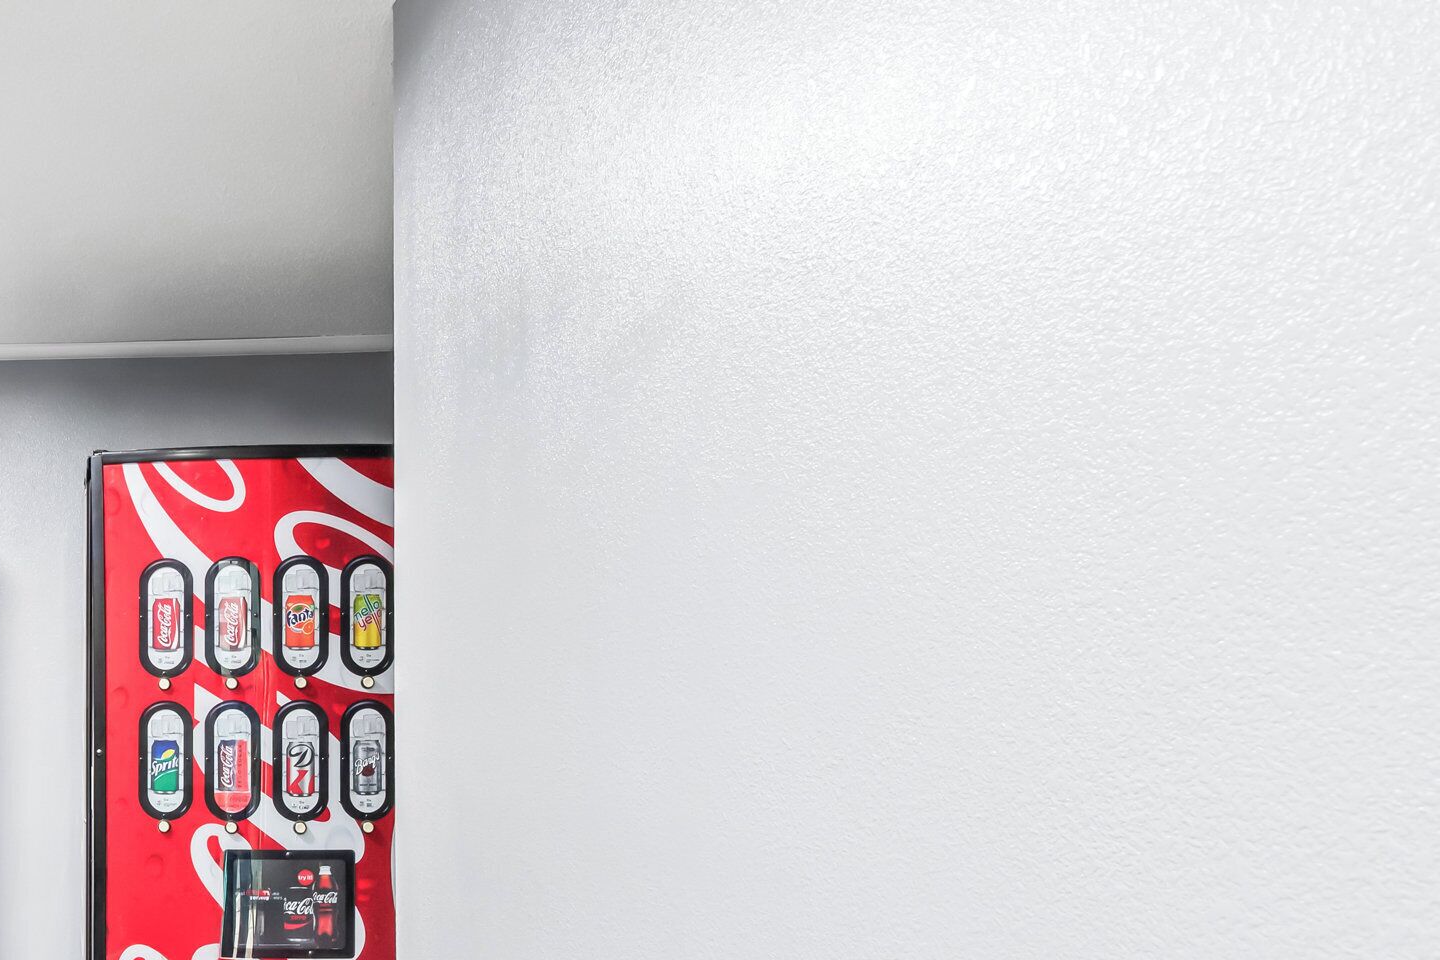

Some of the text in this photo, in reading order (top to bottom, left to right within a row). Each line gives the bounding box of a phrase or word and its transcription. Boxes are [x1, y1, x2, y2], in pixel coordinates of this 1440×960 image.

[157, 602, 172, 647] Coca-Cola
[224, 601, 239, 646] Coca-Cola
[286, 608, 314, 627] Fanta
[354, 594, 380, 621] mello
